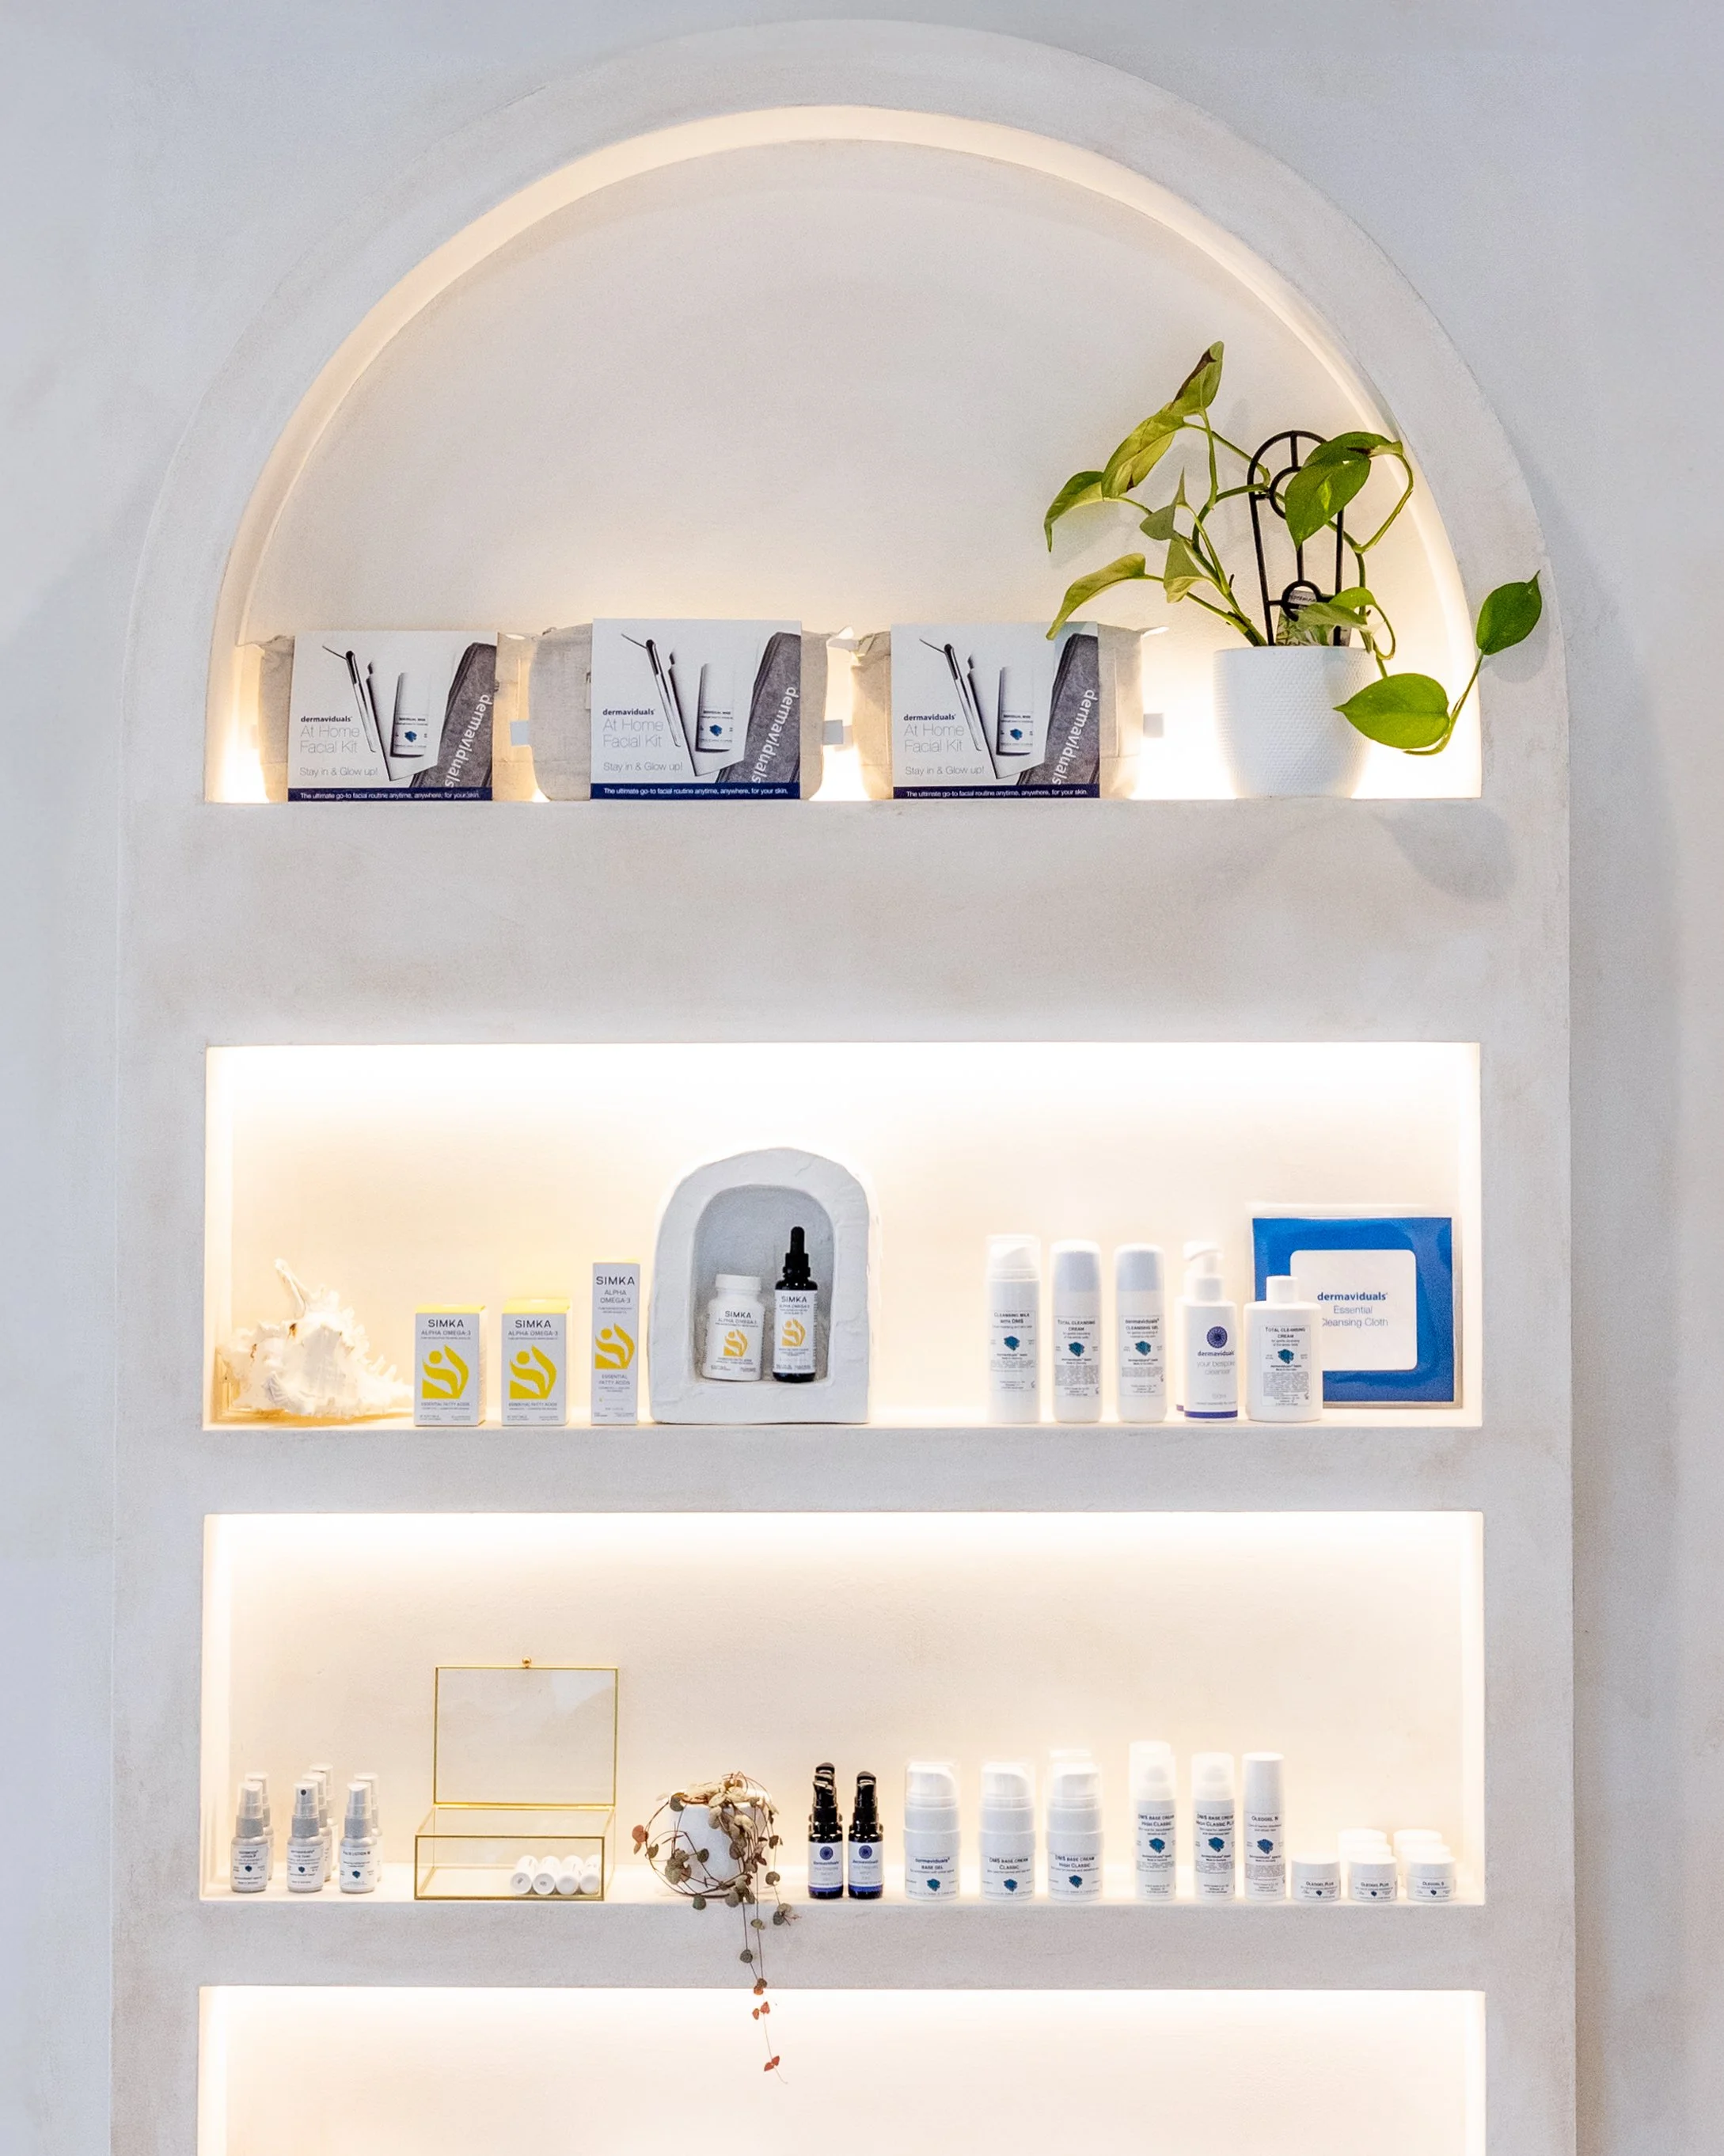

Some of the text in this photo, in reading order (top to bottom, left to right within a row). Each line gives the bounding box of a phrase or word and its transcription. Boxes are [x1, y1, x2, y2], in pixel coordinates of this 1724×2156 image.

[602, 718, 663, 732] At Home
[904, 724, 964, 736] At Home
[300, 724, 360, 738] At Home
[752, 687, 799, 782] dermaviduals
[445, 694, 492, 788] dermaviduals
[603, 734, 662, 747] Facial Kit
[1052, 690, 1098, 785] dermaviduals
[300, 740, 358, 753] Facial Kit
[904, 739, 963, 753] Facial Kit
[300, 767, 318, 777] Stay
[340, 766, 363, 776] Glow
[364, 767, 378, 777] up!
[603, 762, 623, 773] Stay
[635, 762, 641, 771] &
[644, 762, 666, 771] Glow
[669, 762, 682, 772] up!
[905, 766, 924, 777] Stay
[946, 766, 968, 774] Glow
[970, 766, 985, 775] up!
[596, 1276, 635, 1285] SIMKA
[1317, 1292, 1386, 1301] dermaviduals
[1333, 1306, 1373, 1314] Essential
[428, 1319, 464, 1328] SIMKA
[515, 1319, 551, 1328] SIMKA
[1364, 1317, 1388, 1326] Cloth
